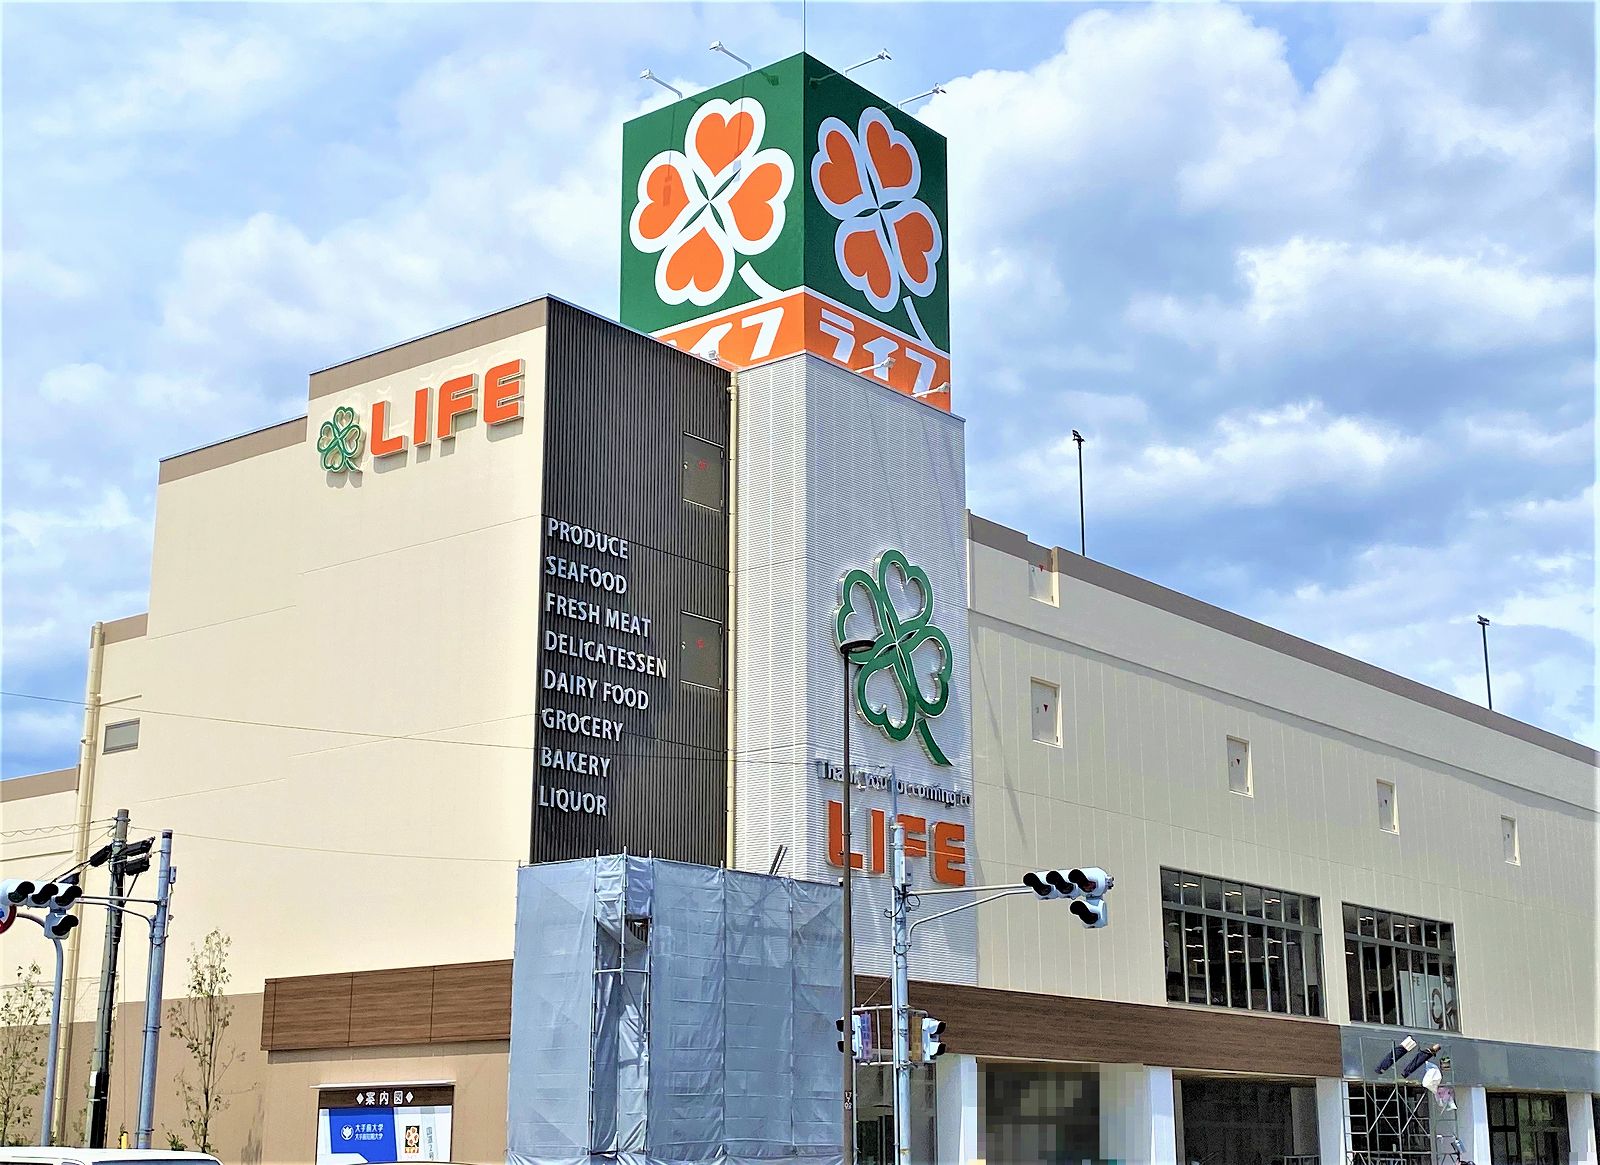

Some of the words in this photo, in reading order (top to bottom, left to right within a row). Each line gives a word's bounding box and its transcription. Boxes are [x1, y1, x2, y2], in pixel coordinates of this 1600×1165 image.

[666, 306, 784, 361] イフ
[819, 307, 938, 398] ライフ
[370, 358, 524, 458] LIFE
[547, 517, 630, 560] PRODUCE
[545, 555, 628, 595] SEAFOOD
[545, 592, 601, 625] FRESH
[605, 608, 652, 638] MEAT
[544, 629, 668, 679] DELICATESSEN
[543, 668, 598, 699] DAIRY
[603, 682, 650, 711] FOOD
[542, 707, 624, 742] GROCERY
[541, 746, 611, 778] BAKERY
[538, 785, 608, 816] LIQUOR
[909, 781, 956, 809] coming
[957, 790, 972, 807] to
[826, 800, 966, 886] LIFE
[365, 1090, 404, 1106] 案内図
